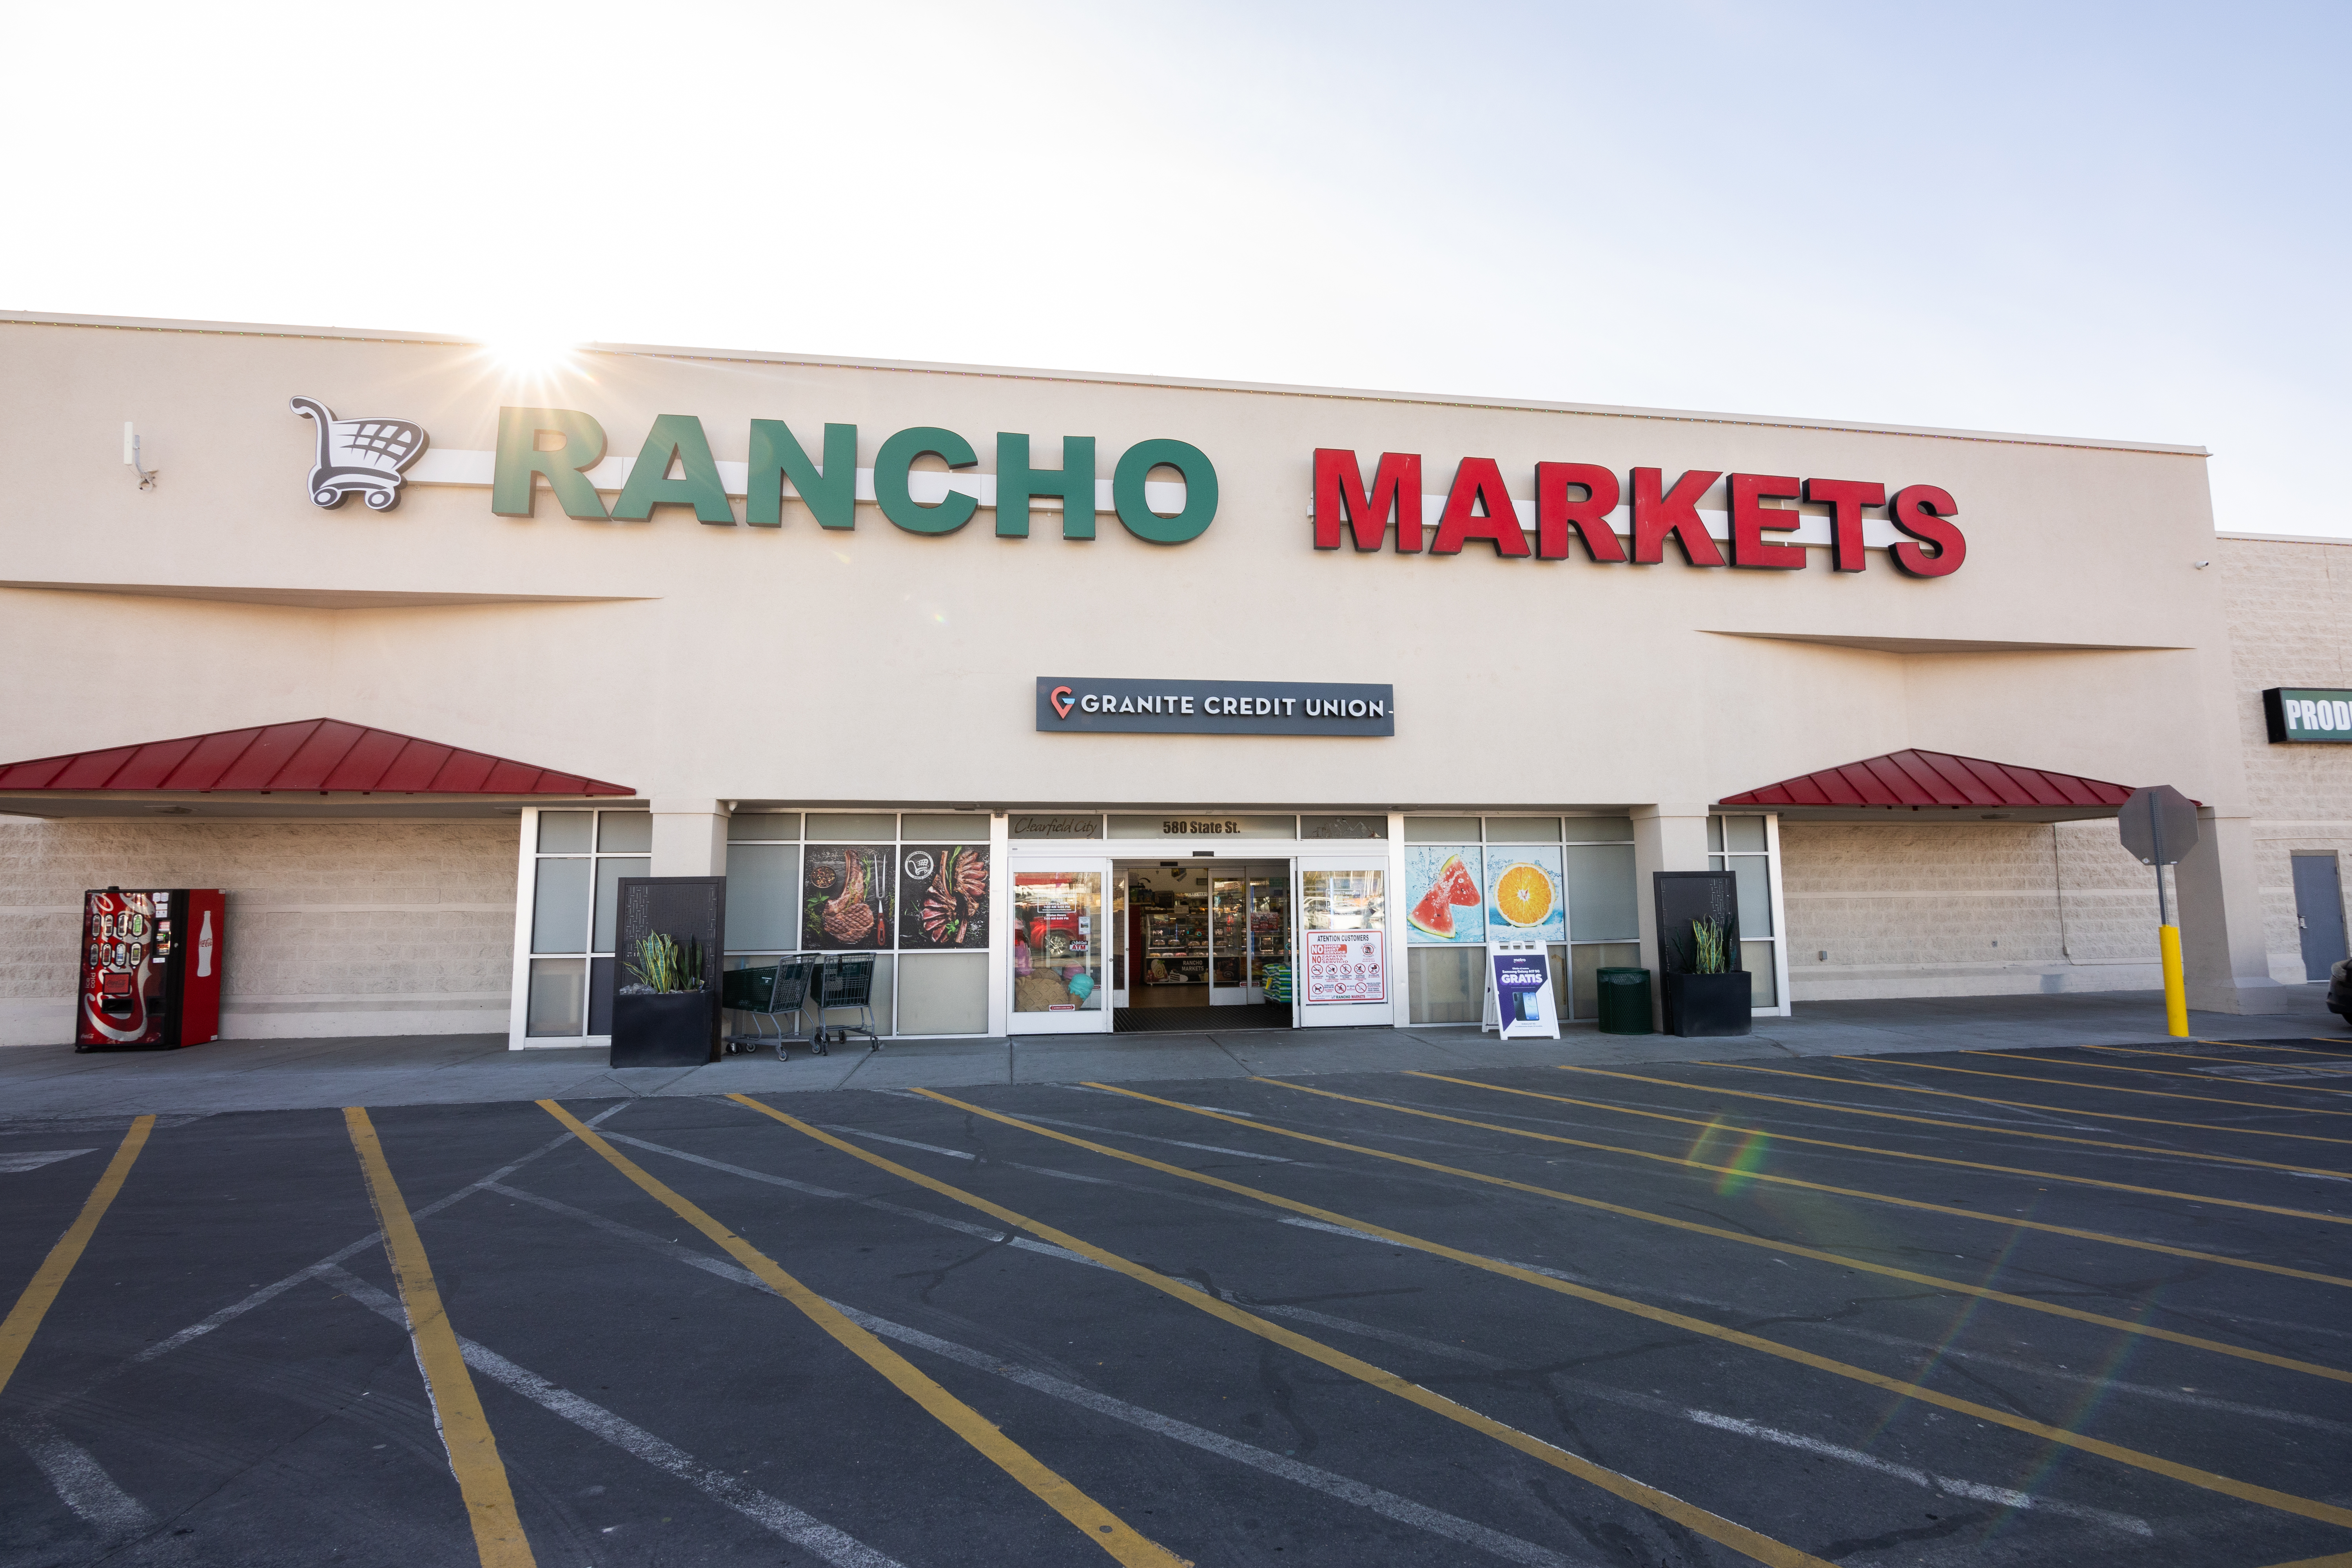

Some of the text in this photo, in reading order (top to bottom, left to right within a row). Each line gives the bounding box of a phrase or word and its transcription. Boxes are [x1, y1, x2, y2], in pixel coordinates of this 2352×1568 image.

[491, 405, 1967, 579] RANCHO MARKETS
[1081, 694, 1194, 715] GRANITE
[1204, 696, 1296, 716] CREDIT
[1305, 698, 1384, 718] UNION
[2285, 699, 2352, 731] PROD
[1014, 817, 1098, 837] Clearfield City
[1163, 821, 1240, 834] 580 State St.
[907, 852, 916, 861] RANCHO
[1311, 945, 1323, 954] NO
[1501, 974, 1543, 984] GRATIS
